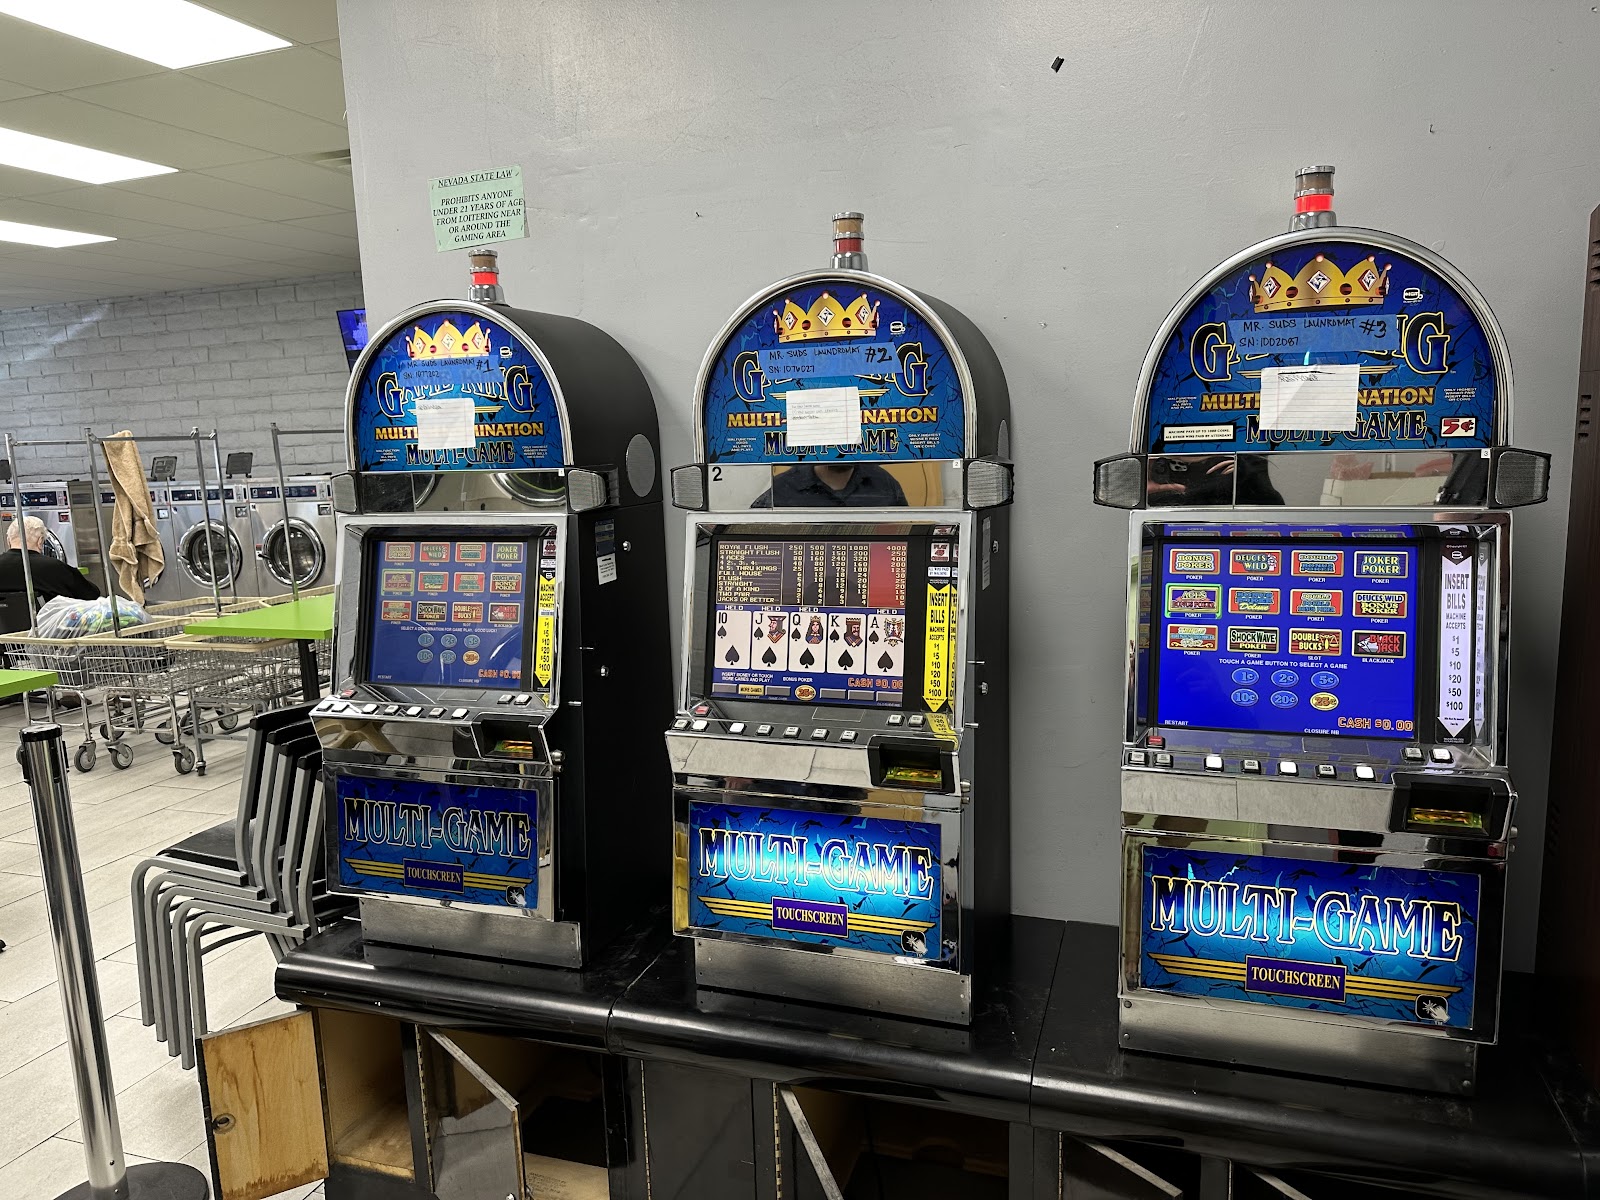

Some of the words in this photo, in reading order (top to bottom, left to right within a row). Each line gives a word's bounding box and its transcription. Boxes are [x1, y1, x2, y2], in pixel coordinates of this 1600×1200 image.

[438, 176, 469, 187] NEVADA
[470, 172, 494, 182] STATE
[496, 169, 513, 179] LAW
[441, 194, 480, 206] PROHIBITS
[480, 190, 513, 200] ANYONE
[433, 206, 458, 216] UNDER
[460, 205, 468, 213] 21
[470, 202, 494, 212] YEARS
[495, 200, 506, 208] OF
[508, 198, 523, 207] AGE
[436, 216, 457, 226] FROM
[459, 211, 499, 223] LOITERING
[500, 208, 521, 218] NEAR
[448, 226, 459, 234] OR
[460, 221, 493, 233] AROUND
[495, 219, 511, 228] THE
[454, 232, 484, 242] GAMING
[485, 230, 506, 239] AREA
[1243, 321, 1264, 332] MR.
[1268, 318, 1297, 329] SUDS
[1359, 318, 1387, 339] #3
[769, 351, 785, 360] MR.
[786, 349, 808, 359] SUDS
[813, 346, 861, 357] LAUNDROMAT
[864, 346, 893, 363] #2
[421, 360, 438, 368] SUDS
[476, 359, 494, 374] #1
[1442, 418, 1475, 435] 5¢
[712, 466, 723, 482] 2
[1235, 554, 1266, 562] DEUCES
[1363, 556, 1399, 565] JOKER
[1244, 562, 1268, 570] WILD
[1362, 565, 1400, 574] POKER
[1444, 574, 1470, 590] INSERT
[929, 593, 948, 607] INSERT
[1384, 594, 1403, 602] WILD
[1446, 593, 1466, 609] BILLS
[1239, 602, 1270, 611] Deluxe
[718, 612, 728, 624] 10
[755, 613, 764, 625] J
[792, 614, 801, 626] Q
[830, 615, 840, 628] K
[870, 616, 880, 629] A
[930, 609, 945, 624] BILLS
[1446, 622, 1466, 630] ACCEPTS
[1292, 633, 1320, 641] DOUBLE
[1369, 634, 1401, 643] BLACK
[1452, 635, 1460, 645] $1
[934, 643, 940, 651] $1
[1298, 642, 1323, 650] BUCKS
[1377, 643, 1401, 653] JACK
[1451, 648, 1460, 656] $5
[933, 652, 940, 660] $5
[931, 661, 941, 669] $10
[1449, 661, 1462, 670] $10
[931, 670, 941, 678] $20
[1448, 675, 1462, 684] $20
[847, 678, 874, 688] CASH
[930, 680, 941, 688] $50
[928, 689, 942, 697] $100
[1448, 688, 1462, 697] $50
[1446, 701, 1463, 711] $100
[1337, 716, 1372, 729] CASH
[1374, 718, 1414, 732] $0.00
[343, 798, 531, 859] MULTI-GAME
[699, 828, 934, 901] MULTI-GAME
[406, 867, 462, 884] TOUCHSCREEN
[775, 905, 845, 927] TOUCHSCREEN
[1150, 875, 1464, 962] MULTI-GAME
[1250, 966, 1342, 990] TOUCHSCREEN
